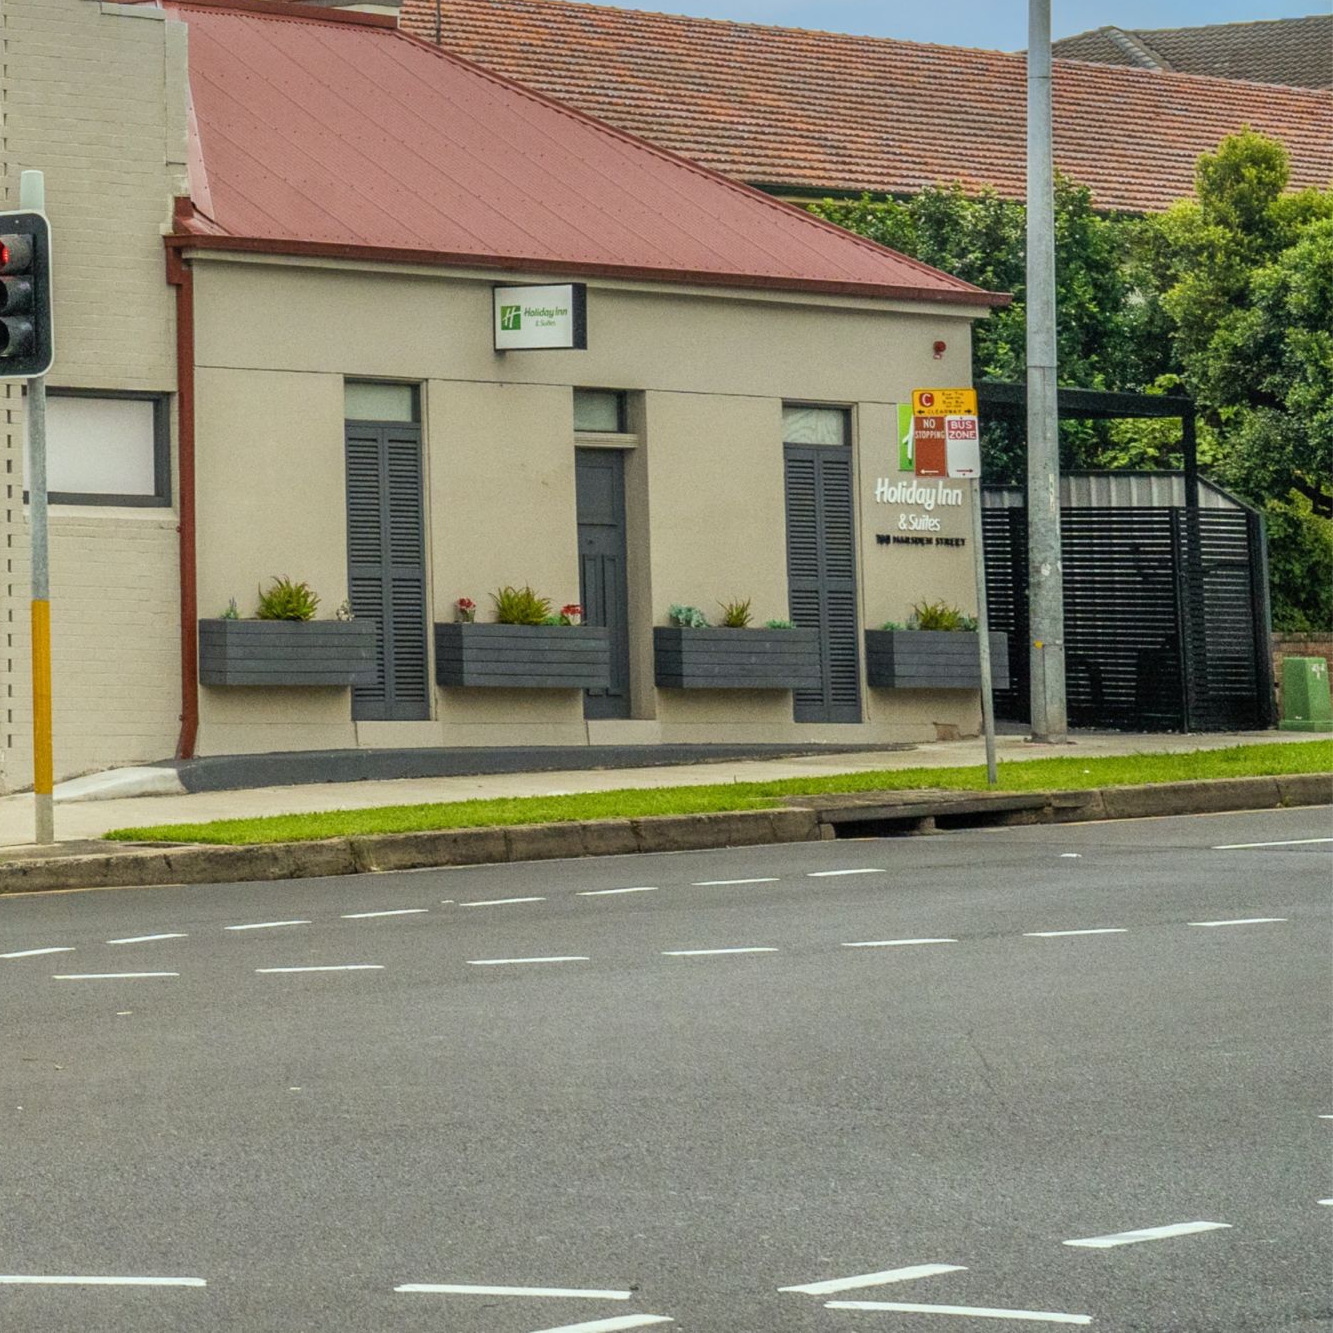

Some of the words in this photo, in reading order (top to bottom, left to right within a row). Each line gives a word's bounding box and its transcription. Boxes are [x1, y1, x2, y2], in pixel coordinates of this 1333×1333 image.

[524, 306, 554, 318] Holiday
[555, 306, 568, 316] Inn
[923, 418, 936, 429] NO
[950, 420, 973, 430] BUS
[915, 430, 945, 439] STOPPING
[949, 430, 976, 439] ZONE
[875, 477, 936, 511] Holiday
[937, 480, 963, 506] Inn
[898, 513, 907, 530] &
[908, 514, 941, 532] Suites
